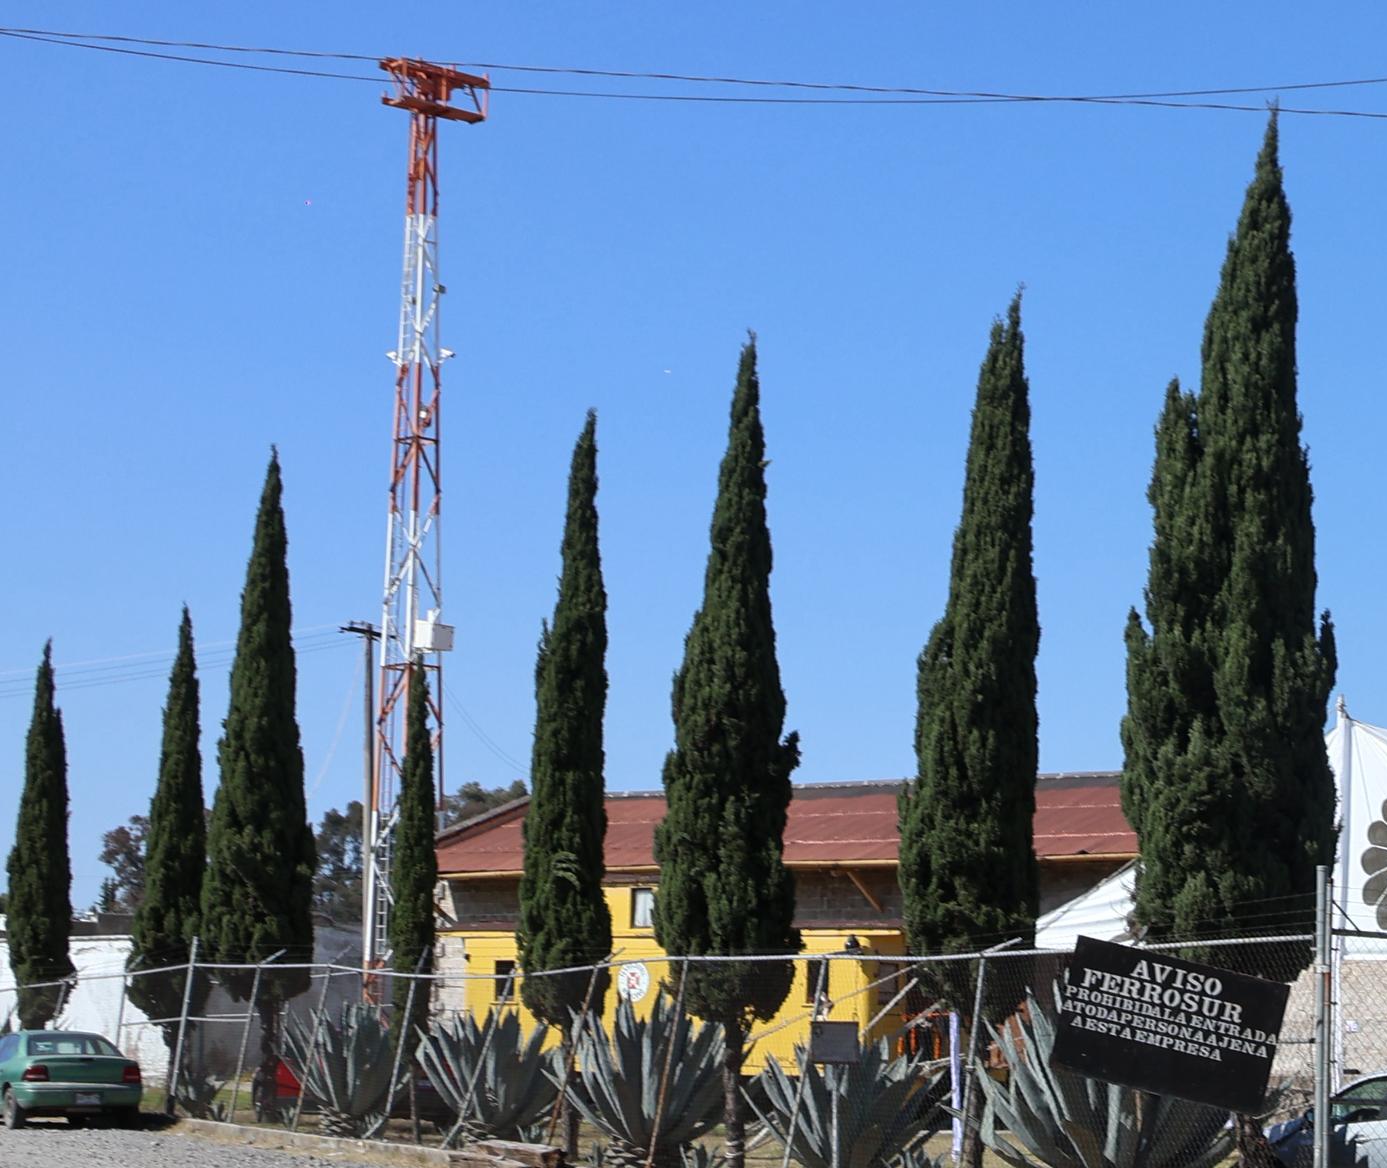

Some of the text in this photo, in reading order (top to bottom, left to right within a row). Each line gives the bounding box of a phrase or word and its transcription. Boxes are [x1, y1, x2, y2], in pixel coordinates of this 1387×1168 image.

[1081, 968, 1243, 1023] FERROSUR
[1130, 959, 1222, 996] AVISO
[1065, 984, 1278, 1046] PROHIBIDA LA ENTRADA
[1120, 1012, 1205, 1044] PERSONA
[1206, 1033, 1268, 1059] AJENA
[1133, 1029, 1222, 1062] EMPRESA
